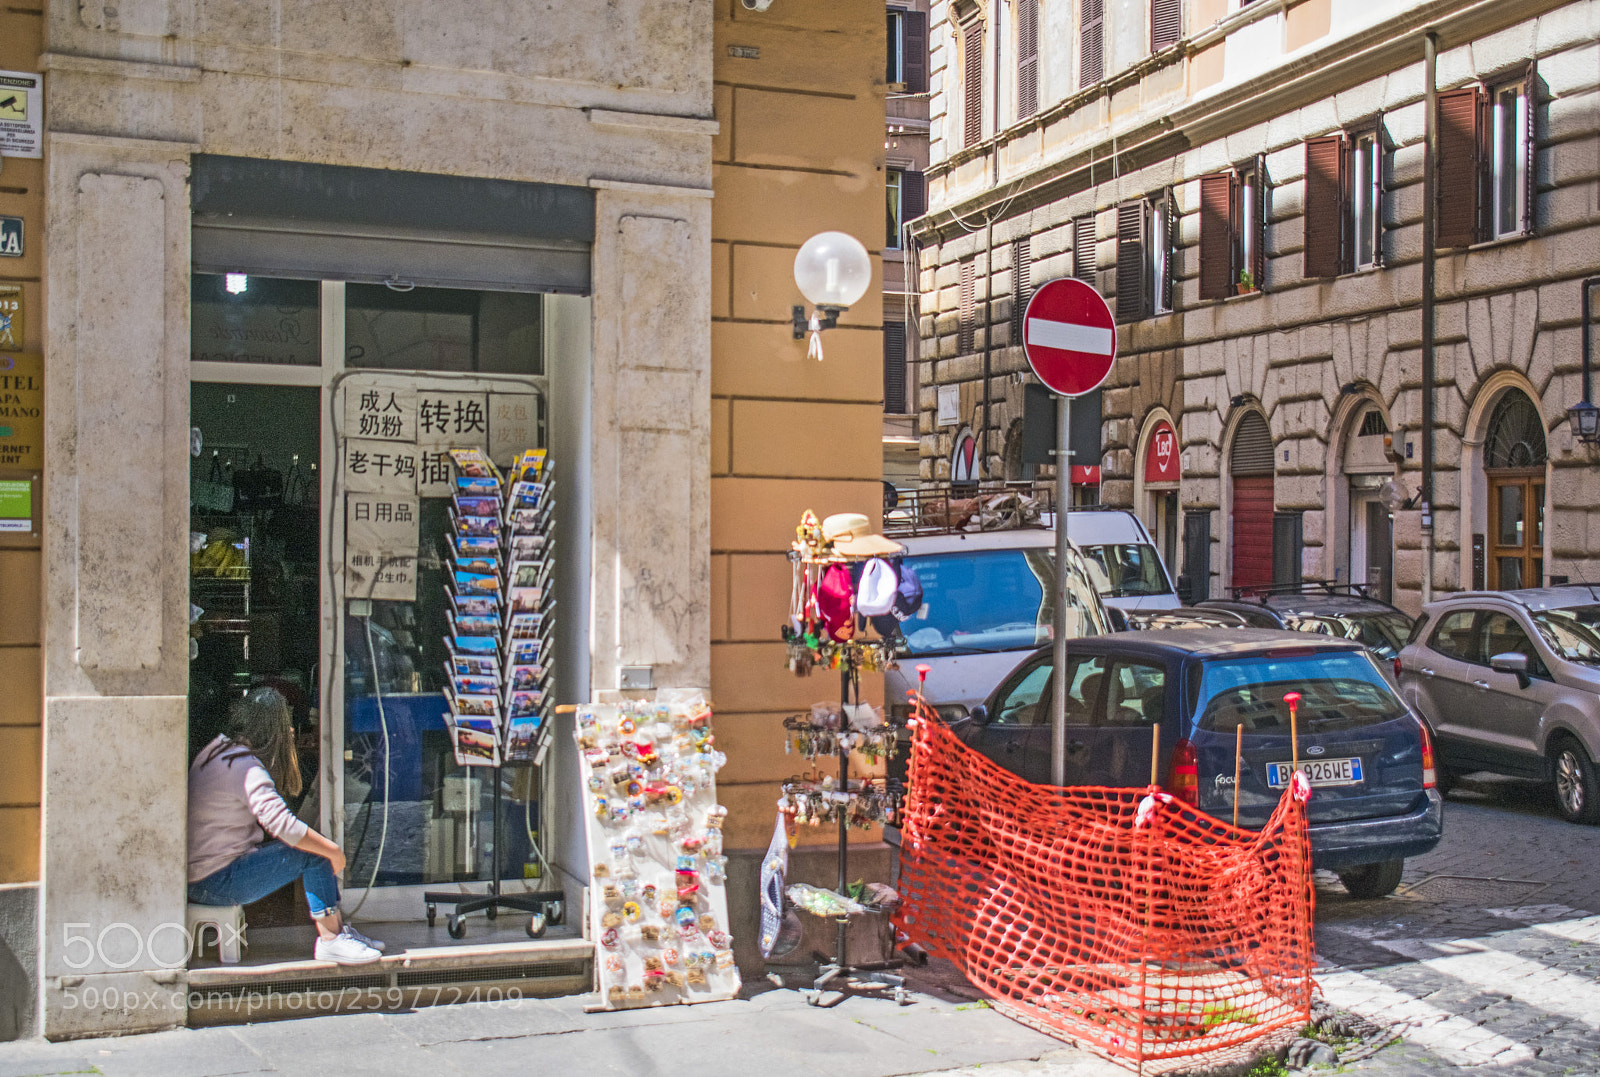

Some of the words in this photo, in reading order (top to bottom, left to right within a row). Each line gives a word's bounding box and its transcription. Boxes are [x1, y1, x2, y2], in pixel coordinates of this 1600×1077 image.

[0, 300, 19, 311] 13
[0, 375, 40, 391] TEL
[359, 389, 403, 413] 成人
[359, 413, 403, 437] 奶粉
[420, 399, 485, 434] 转换
[349, 450, 415, 478] 老干妈
[421, 450, 449, 485] 插
[355, 502, 412, 523] 日用品
[1304, 762, 1351, 780] 926WE
